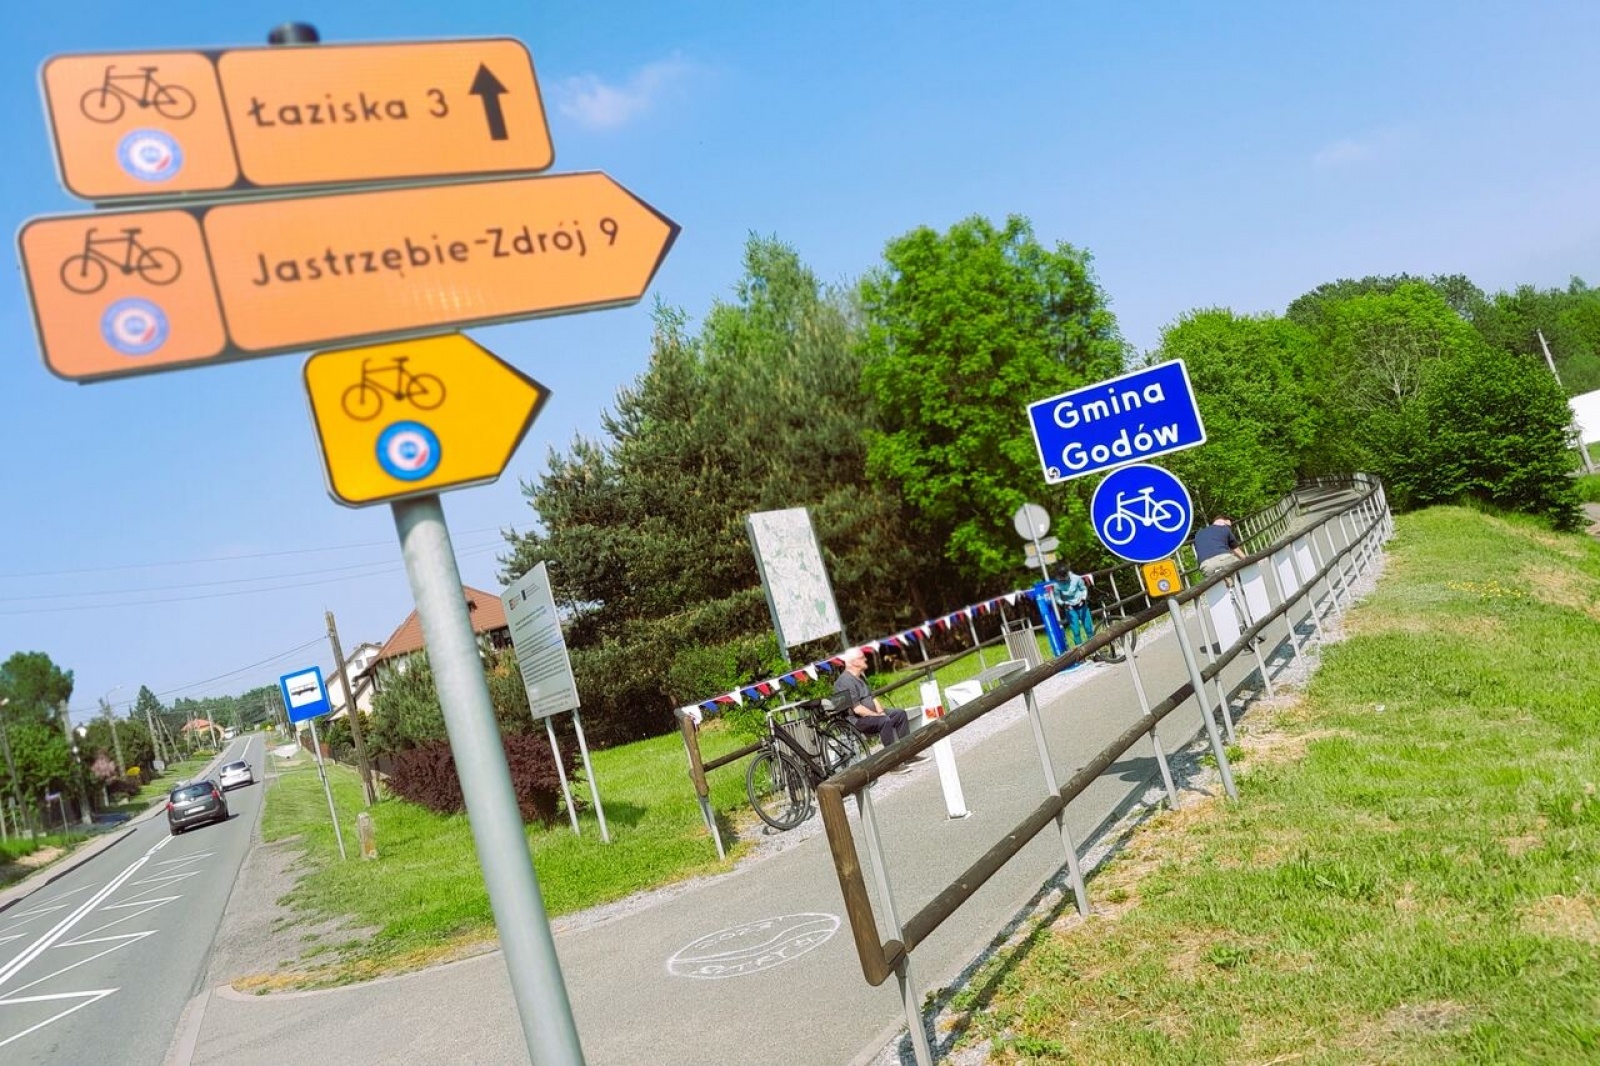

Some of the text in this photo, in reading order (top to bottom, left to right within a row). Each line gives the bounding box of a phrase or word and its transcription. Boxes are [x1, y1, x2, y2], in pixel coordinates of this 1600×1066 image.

[247, 87, 449, 128] Łaziska 3
[252, 216, 619, 287] Jastrzębie-Zdrój 9
[1053, 381, 1166, 429] Gmina
[1061, 422, 1179, 470] Godów
